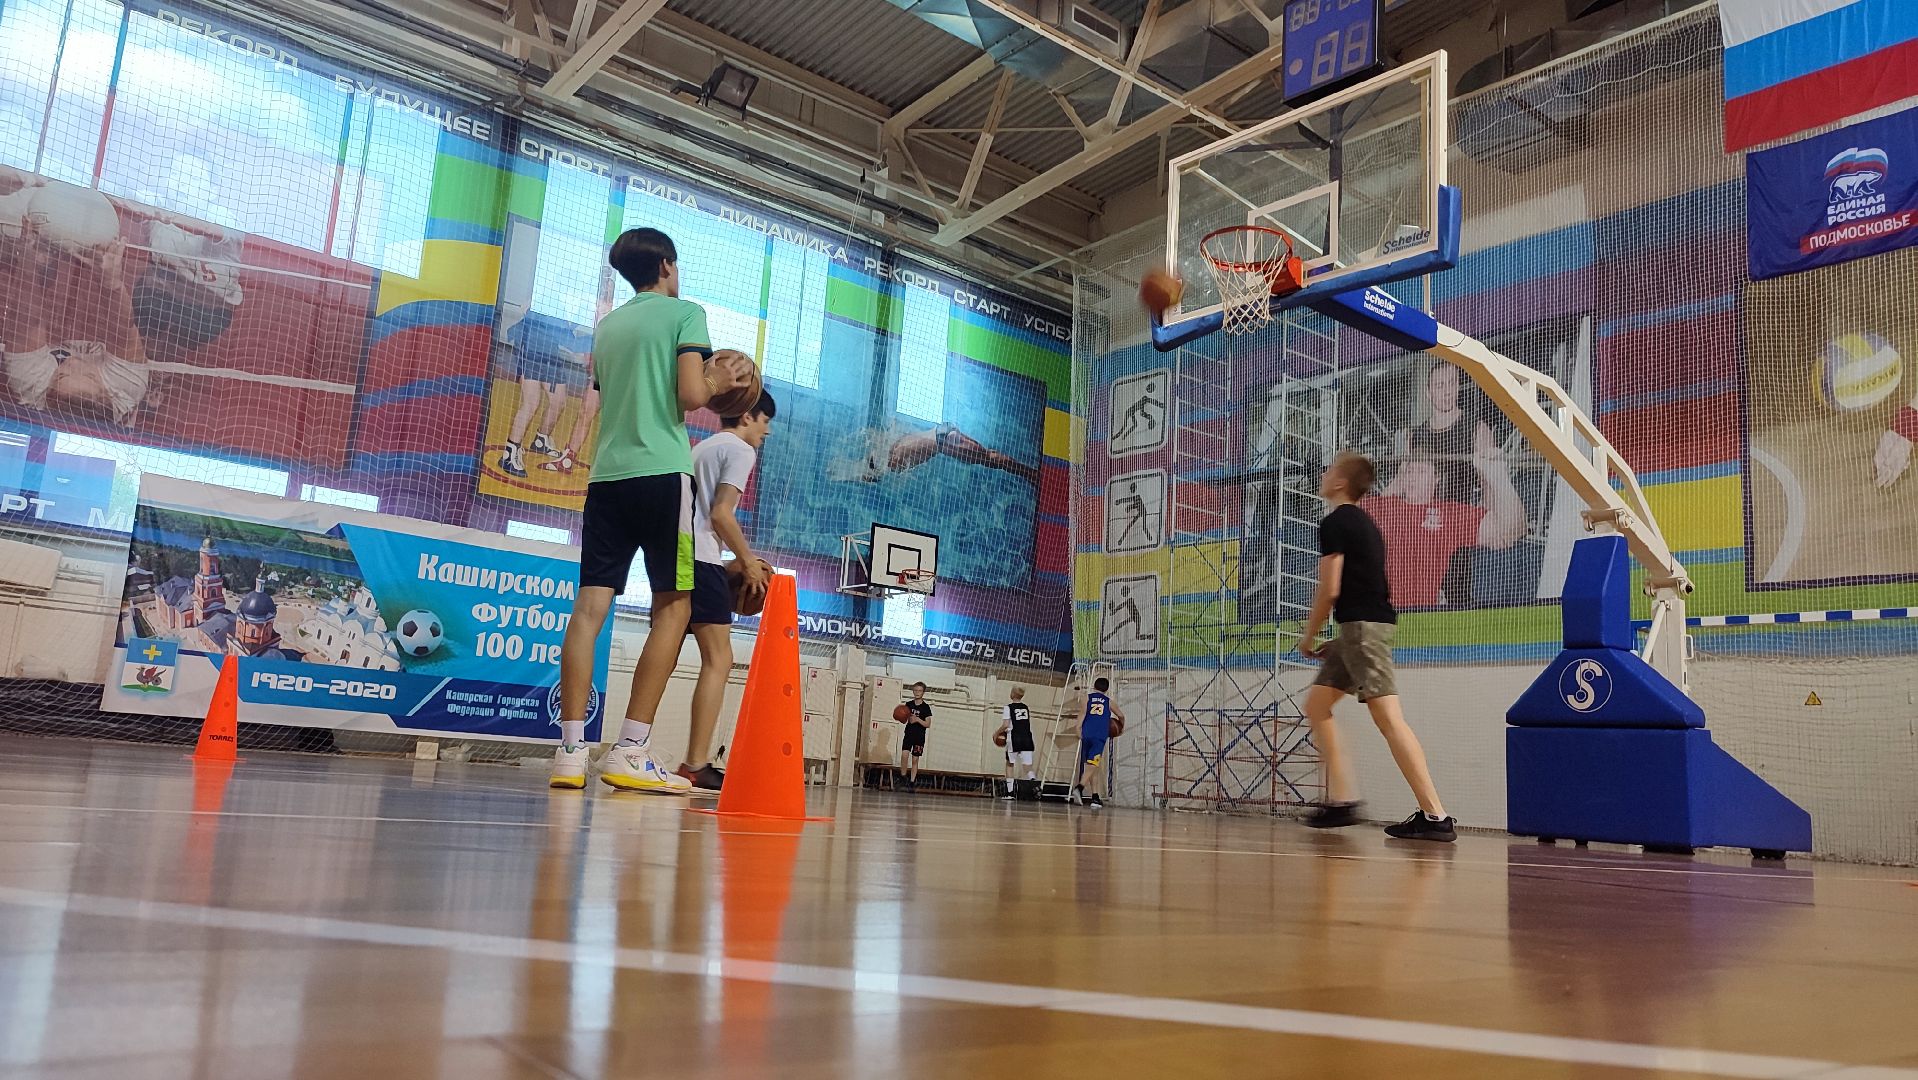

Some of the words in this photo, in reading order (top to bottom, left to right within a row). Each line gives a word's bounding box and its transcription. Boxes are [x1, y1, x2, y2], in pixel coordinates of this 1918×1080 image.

[157, 9, 299, 77] РЕКОРД
[335, 74, 491, 141] БУДУЩЕЕ
[1827, 193, 1885, 215] ЕДИНАЯ
[1827, 204, 1886, 226] РОССИЯ
[520, 138, 609, 176] СПОРТ
[628, 175, 700, 209] СИЛА
[719, 205, 848, 264] ДИНАМИКА
[864, 256, 940, 294] РЕКОРД
[954, 289, 1011, 319] СТАРТ
[1809, 214, 1911, 249] ПОДМОСКОВЬЕ
[475, 632, 524, 660] 100
[1007, 647, 1053, 667] ЦЕЛЬ
[1014, 708, 1029, 721] 23
[1090, 703, 1104, 716] 23
